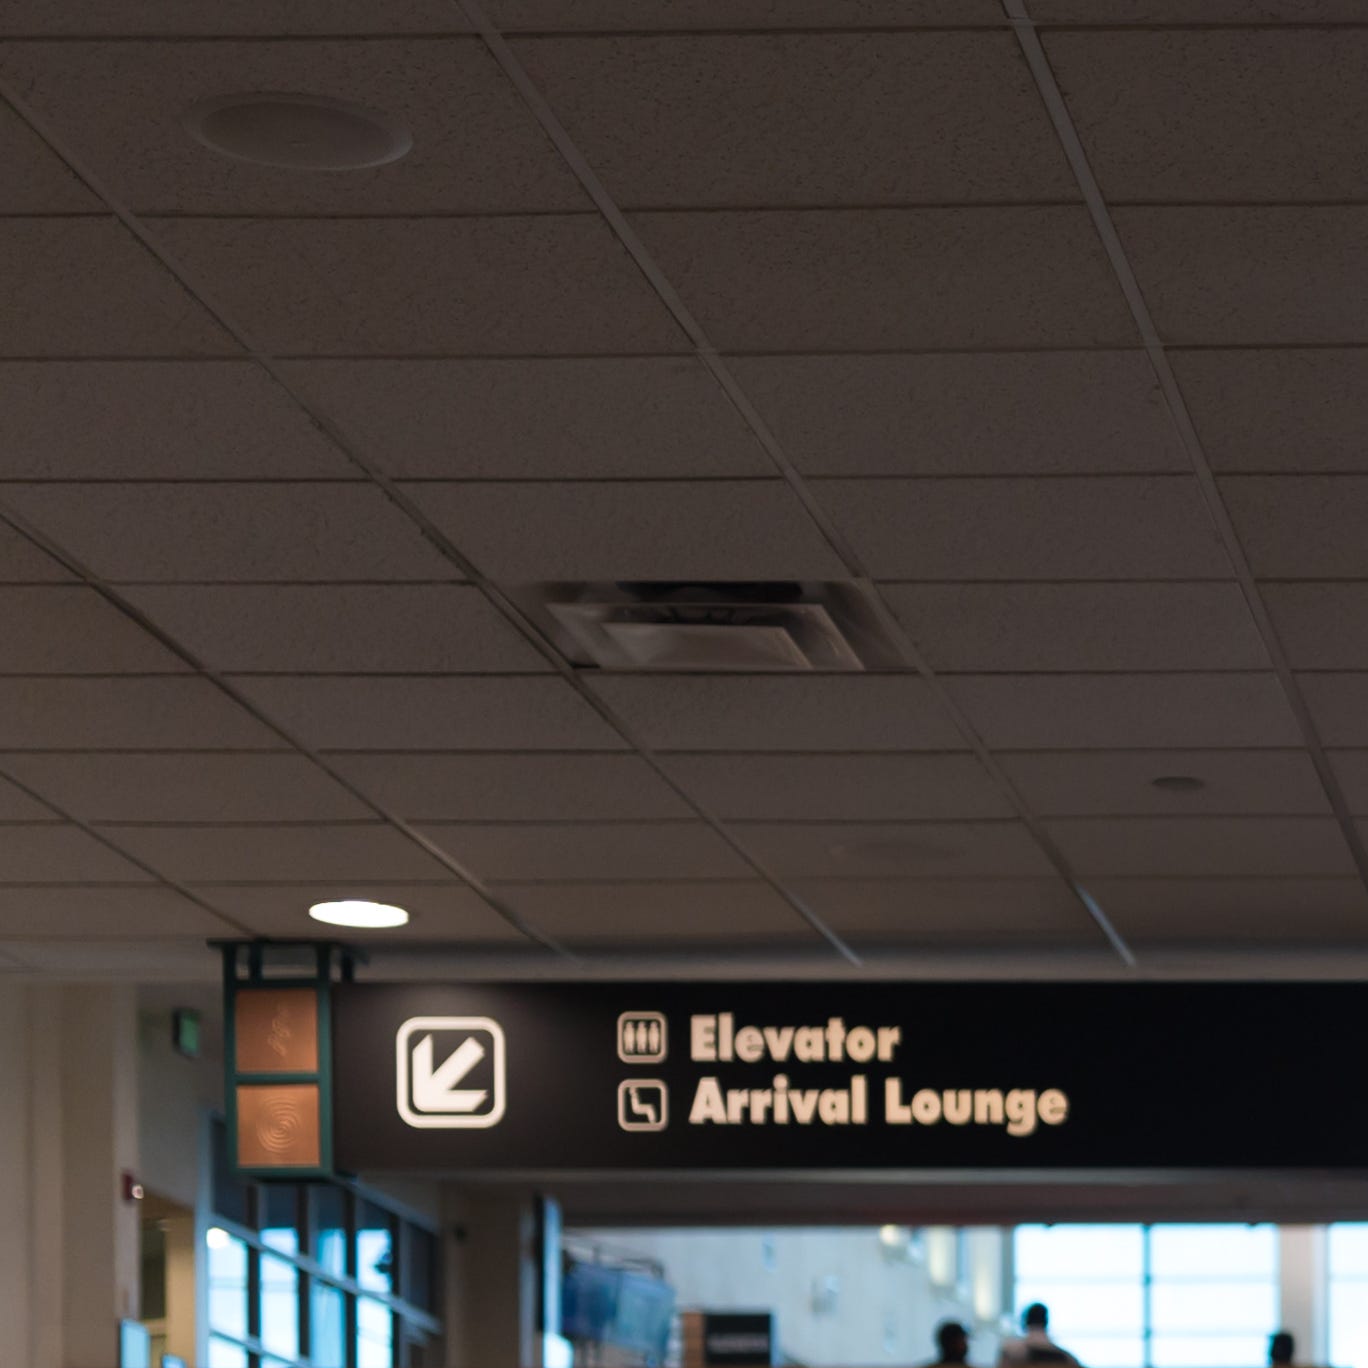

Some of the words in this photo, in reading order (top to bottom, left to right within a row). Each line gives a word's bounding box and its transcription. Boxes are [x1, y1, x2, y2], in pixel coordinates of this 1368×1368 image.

[688, 1012, 901, 1063] Elevator
[687, 1074, 868, 1126] Arrival
[883, 1077, 1069, 1136] Lounge
